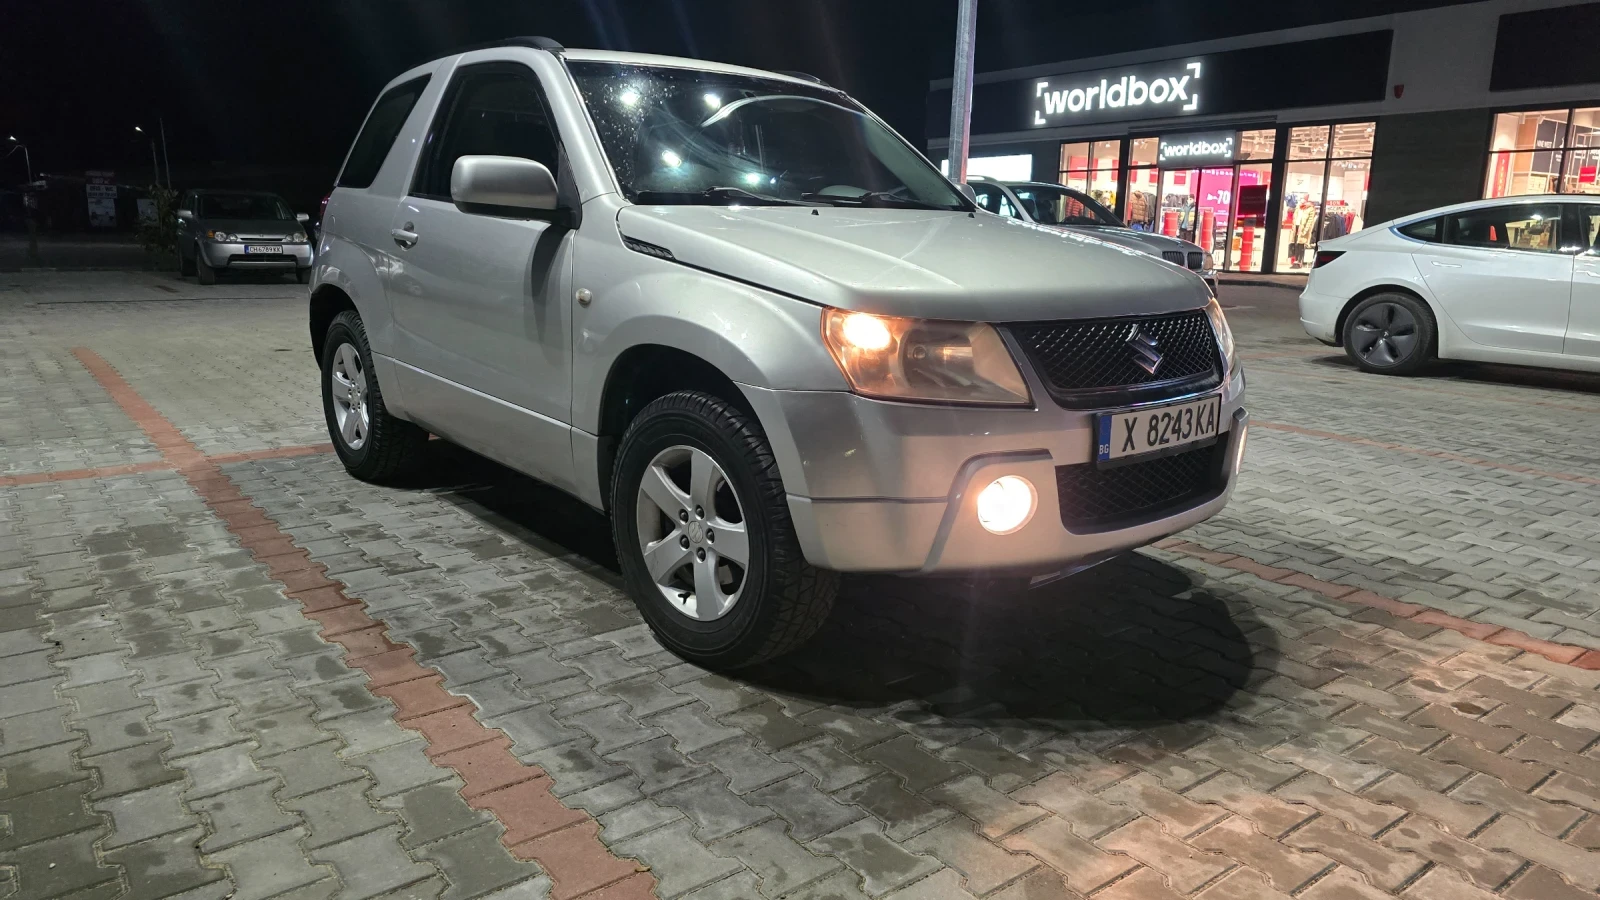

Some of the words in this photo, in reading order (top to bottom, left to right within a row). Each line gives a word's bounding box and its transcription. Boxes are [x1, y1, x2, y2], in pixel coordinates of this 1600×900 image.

[1043, 75, 1190, 115] worldbox
[1163, 141, 1228, 157] worldbox
[1122, 417, 1138, 452] X
[1099, 444, 1109, 455] BG
